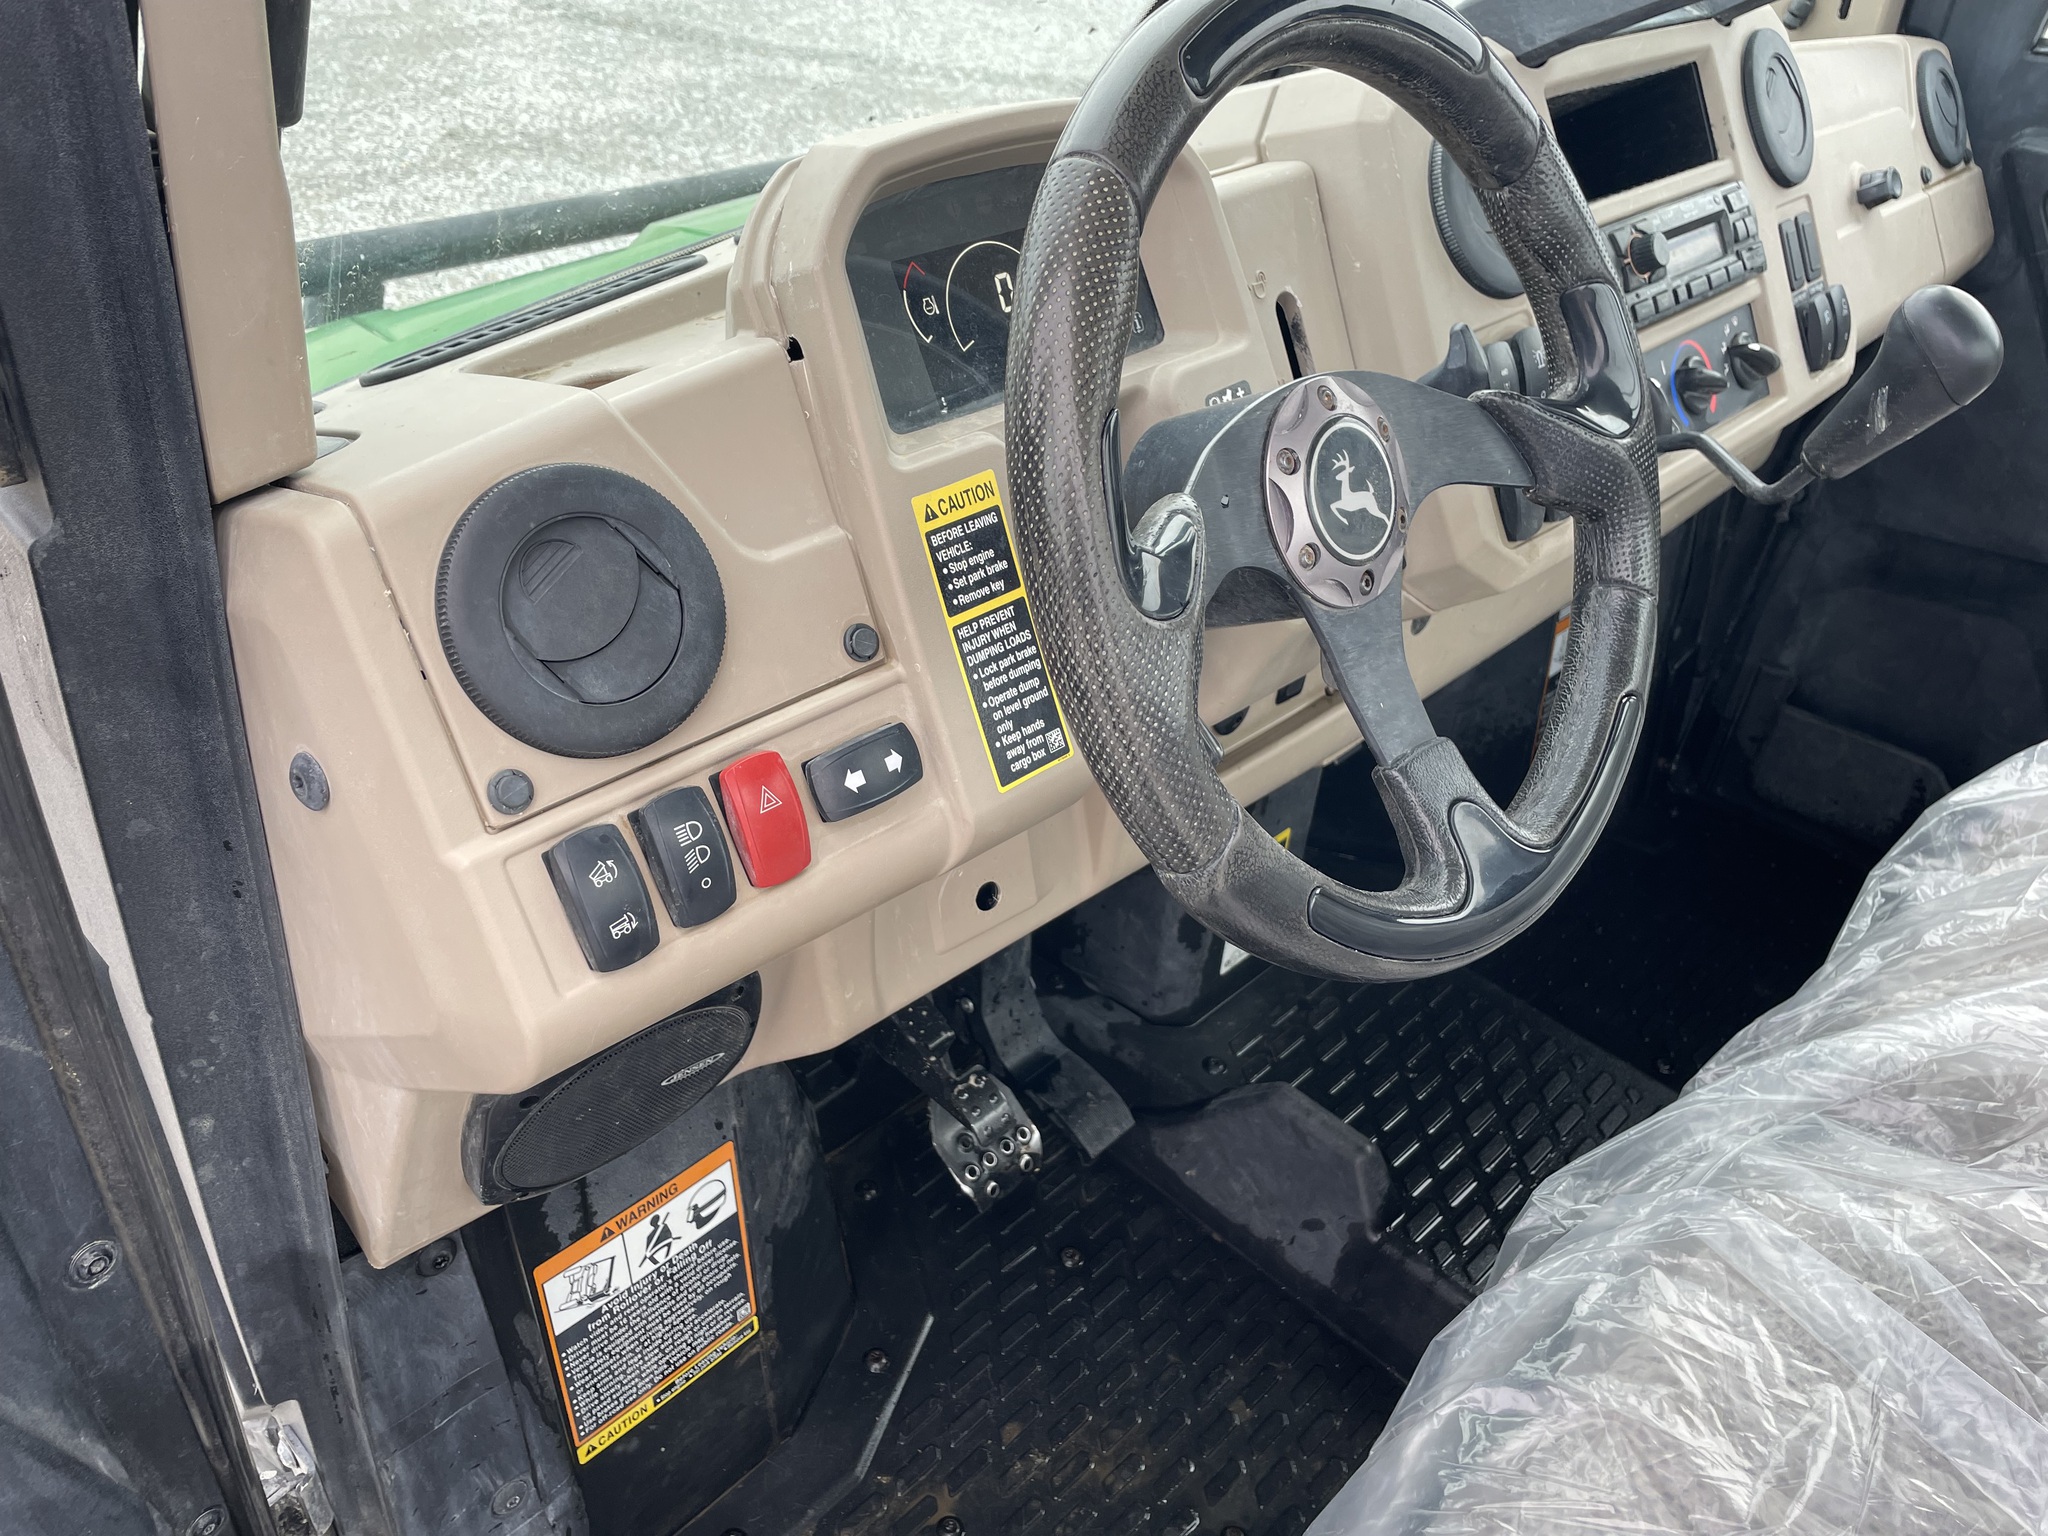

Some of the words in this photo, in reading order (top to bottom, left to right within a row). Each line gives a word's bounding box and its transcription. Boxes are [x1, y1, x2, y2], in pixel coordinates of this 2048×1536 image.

[994, 271, 1014, 313] 0
[936, 479, 995, 516] CAUTION
[930, 524, 964, 547] BEFORE
[963, 510, 998, 534] LEAVING
[935, 538, 973, 563] VEHICLE:
[947, 556, 969, 577] Stop
[967, 545, 996, 569] engine
[952, 574, 968, 590] Set
[966, 566, 987, 586] park
[985, 556, 1008, 576] brake
[957, 583, 990, 606] Remove
[989, 576, 1006, 595] key
[957, 621, 979, 639] HELP
[978, 604, 1016, 630] PREVENT
[961, 631, 992, 653] INJURY
[990, 620, 1016, 640] WHEN
[966, 640, 1004, 667] DUMPING
[1003, 628, 1032, 650] LOADS
[978, 660, 998, 678] Lock
[997, 652, 1017, 671] park
[1014, 642, 1037, 661] brake
[982, 670, 1008, 691] before
[1007, 655, 1041, 682] dumping
[987, 684, 1019, 710] Operate
[1017, 673, 1040, 695] dump
[992, 709, 1003, 721] on
[1002, 697, 1022, 716] level
[1021, 685, 1049, 709] ground
[995, 716, 1014, 737] only
[1001, 727, 1022, 749] Keep
[1020, 716, 1045, 737] hands
[1005, 742, 1026, 762] away
[1024, 731, 1044, 750] from
[1009, 754, 1032, 775] cargo
[1030, 745, 1046, 761] box
[614, 1181, 678, 1232] WARNING
[587, 1309, 610, 1333] from
[612, 1280, 652, 1315] Rollover
[653, 1273, 664, 1287] or
[665, 1249, 697, 1280] Falling
[698, 1237, 712, 1255] Off
[600, 1288, 628, 1314] Avoid
[630, 1268, 658, 1295] Injury
[659, 1260, 670, 1274] or
[671, 1240, 698, 1265] Death
[597, 1402, 647, 1447] CAUTION
